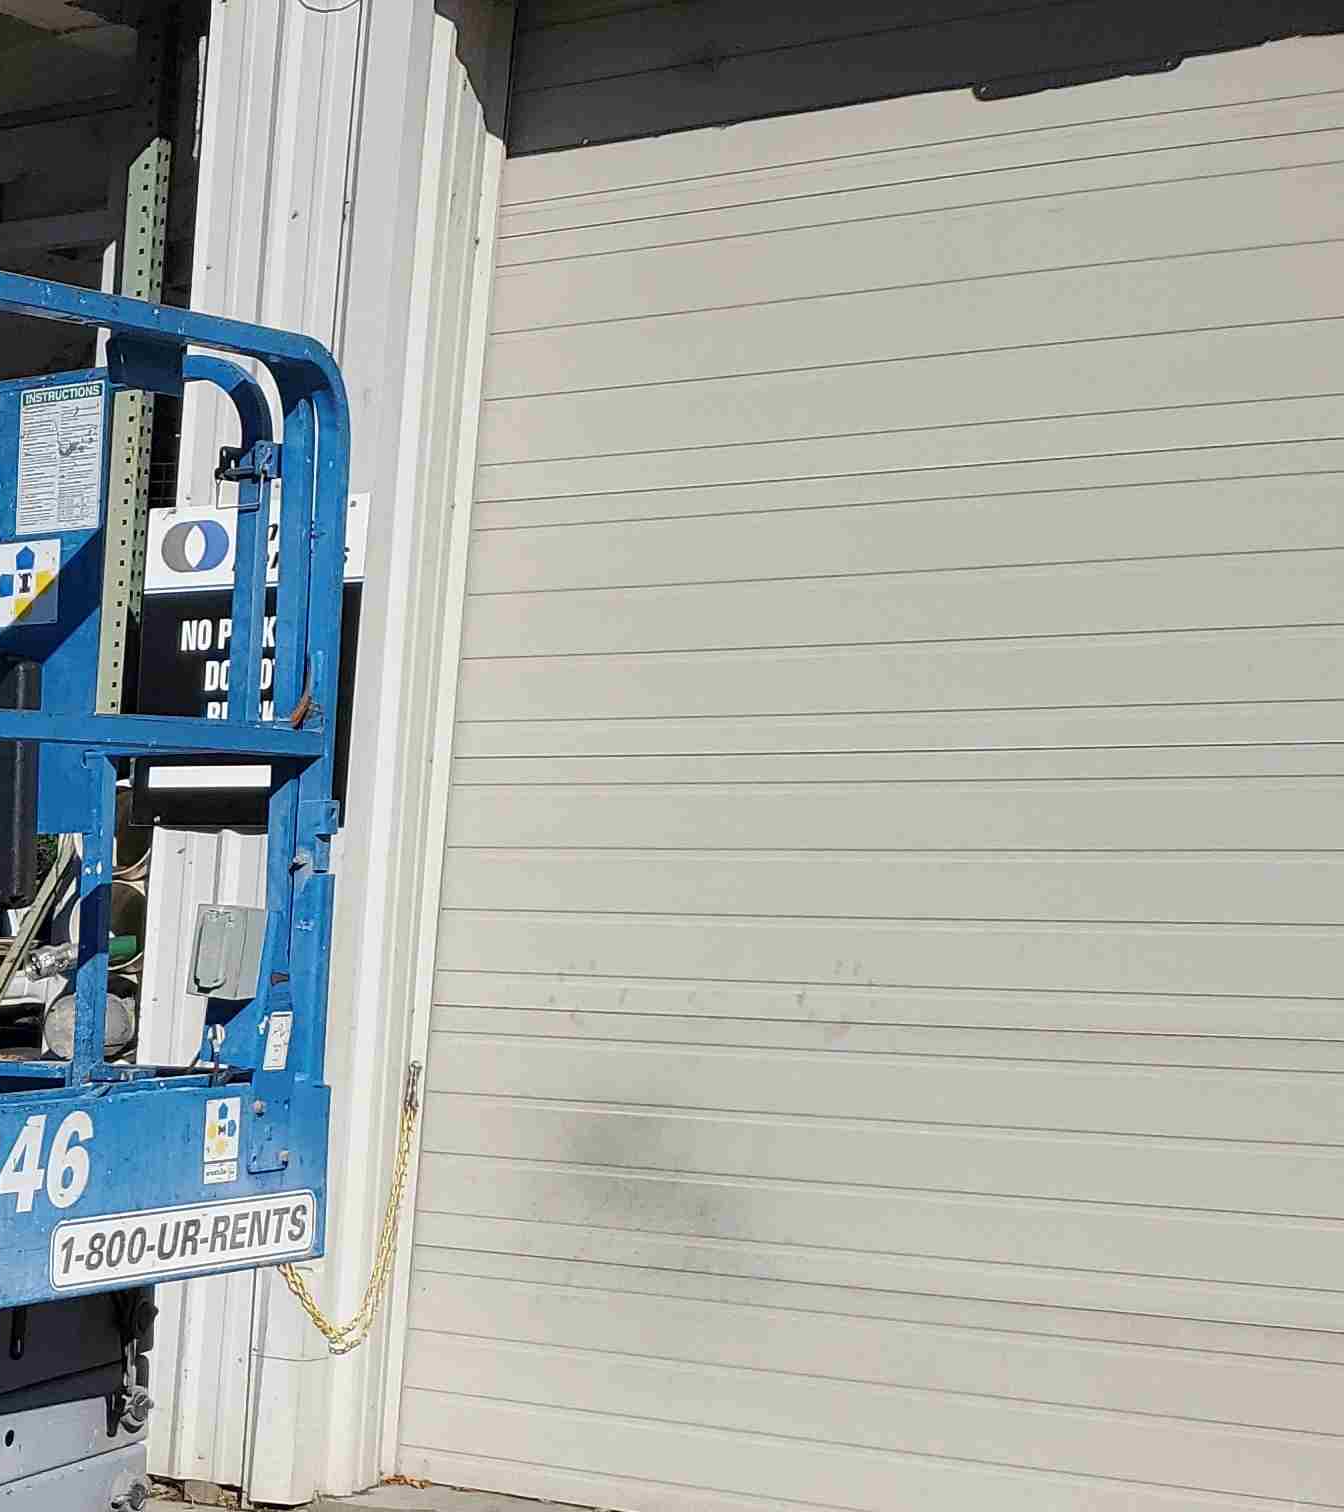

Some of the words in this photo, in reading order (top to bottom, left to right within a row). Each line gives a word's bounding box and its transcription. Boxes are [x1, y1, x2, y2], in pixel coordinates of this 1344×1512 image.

[25, 384, 101, 404] INSTRUCTIONS
[181, 619, 212, 652] NO
[60, 1204, 308, 1276] 1-800-UR-RENTS
